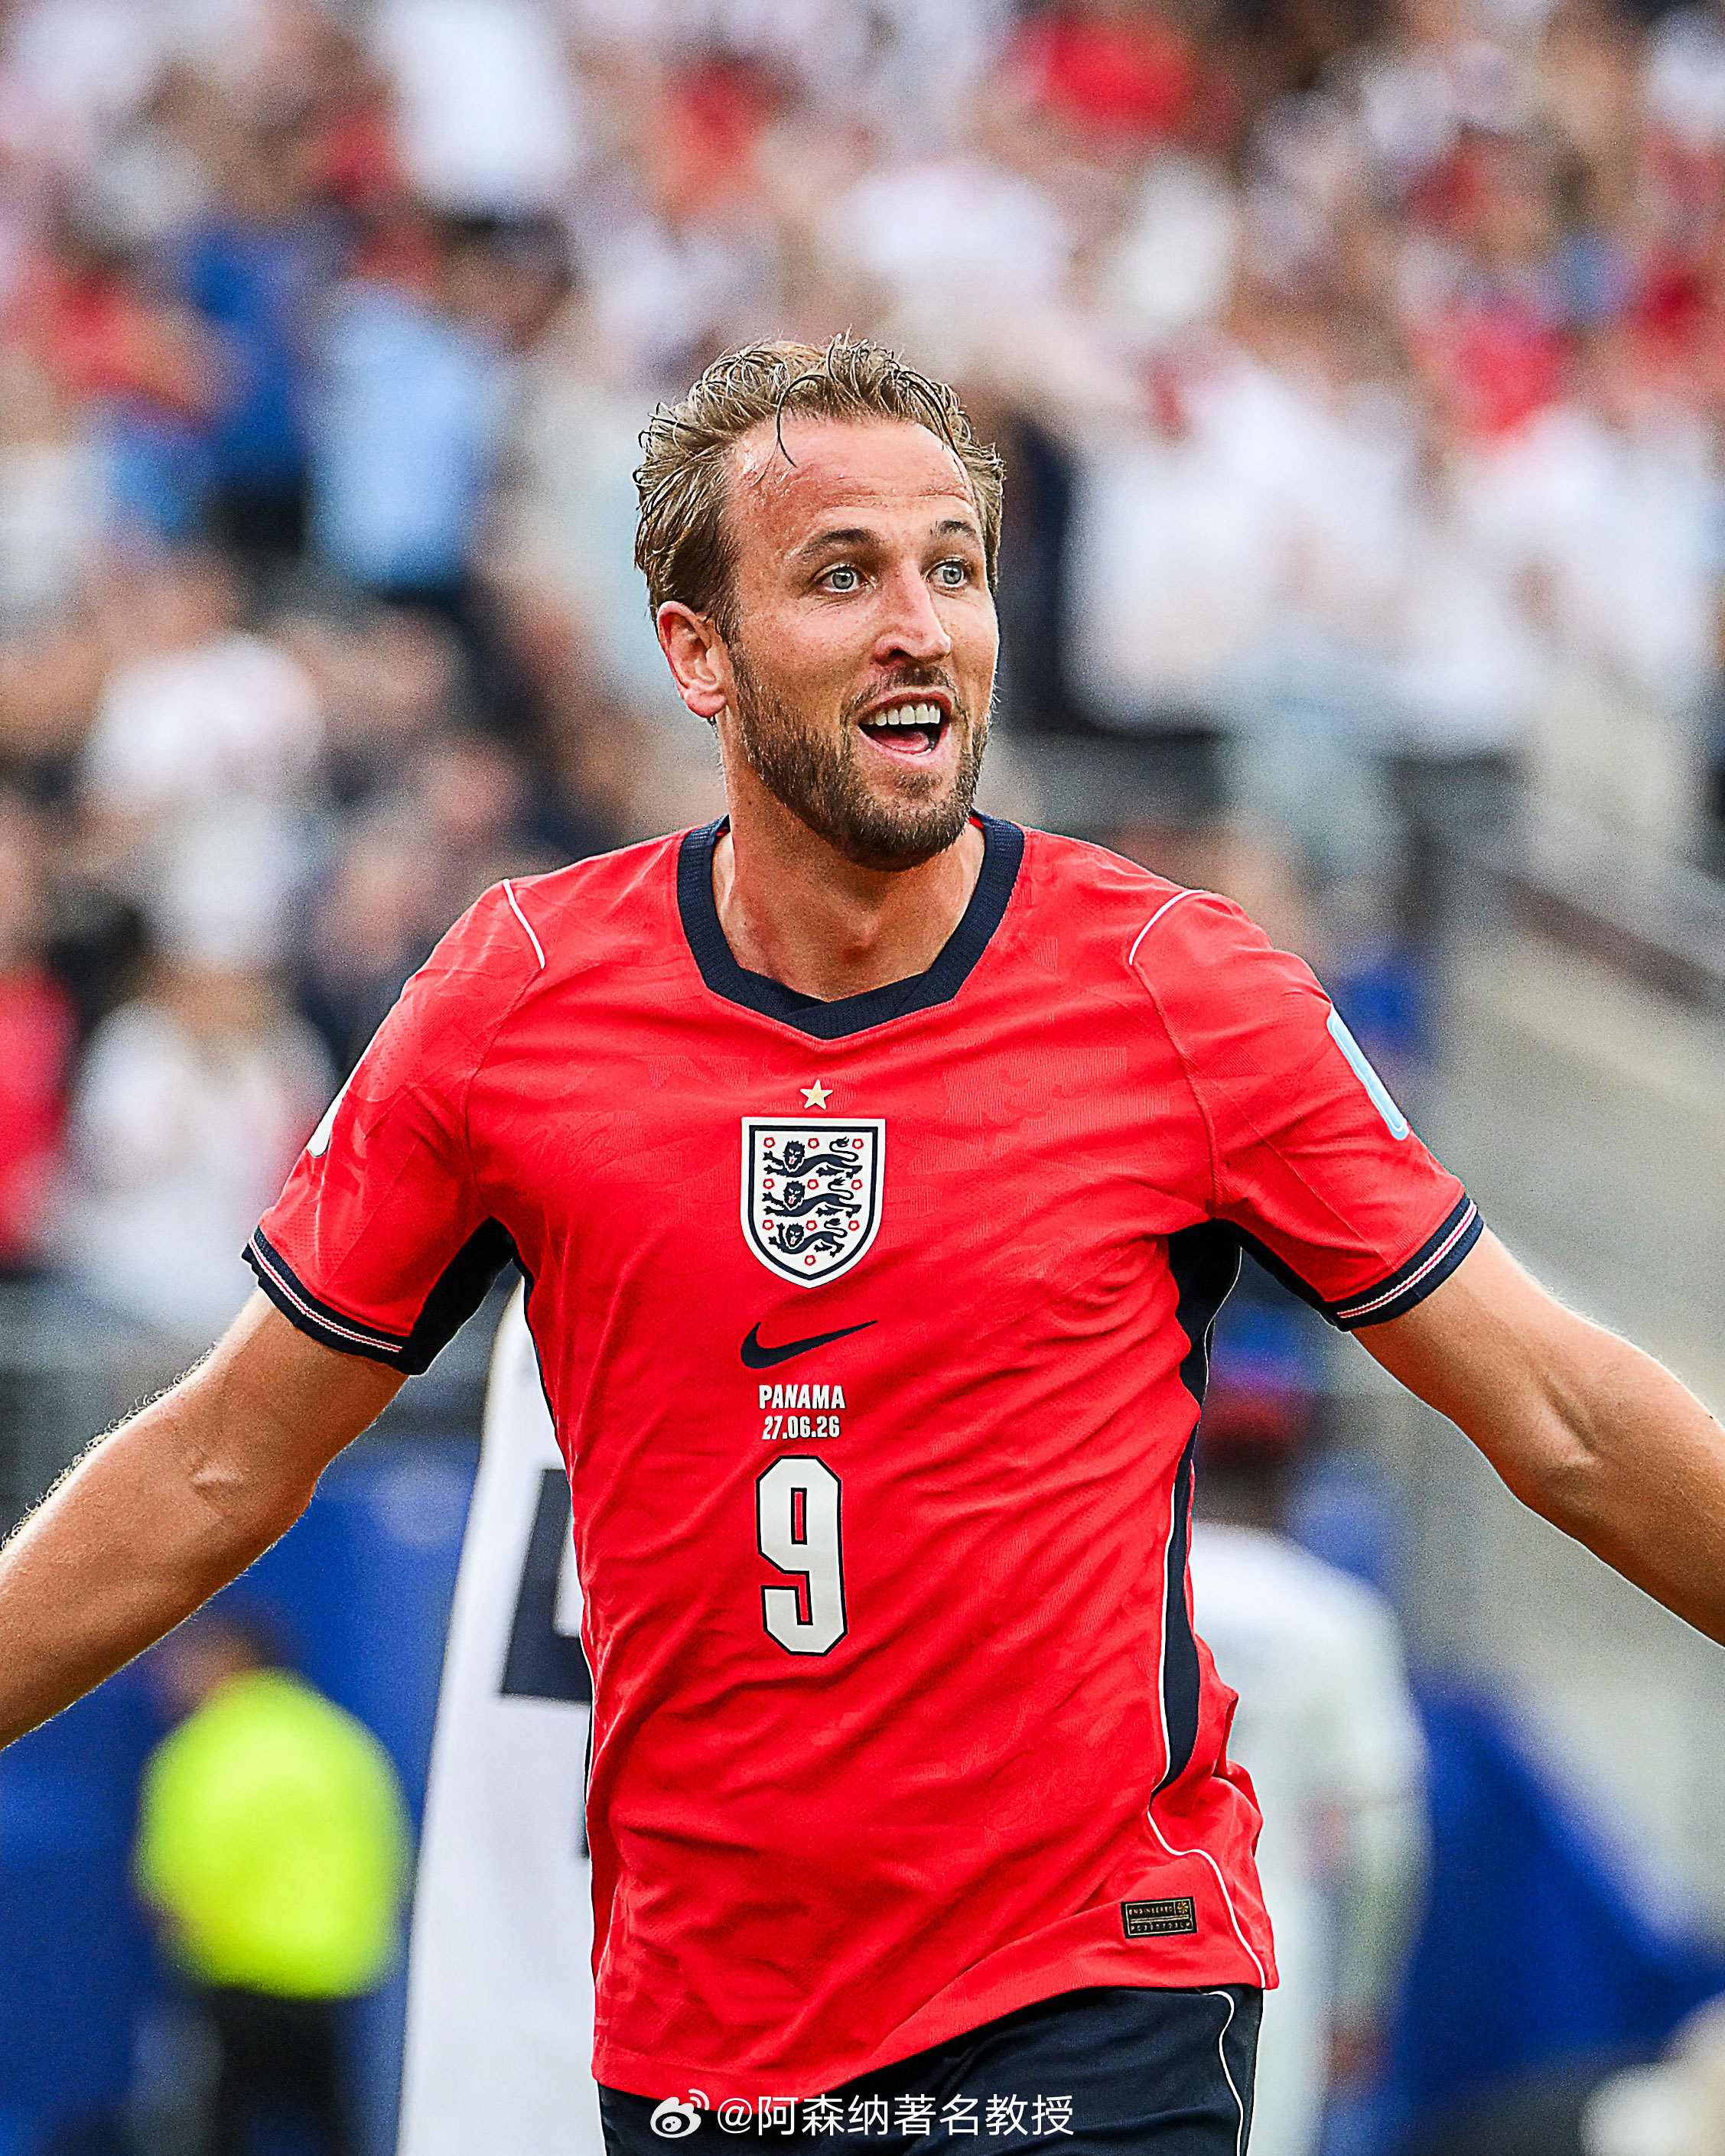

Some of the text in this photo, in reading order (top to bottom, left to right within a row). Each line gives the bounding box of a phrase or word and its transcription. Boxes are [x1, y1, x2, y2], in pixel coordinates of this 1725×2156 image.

[758, 1384, 846, 1409] PANAMA
[762, 1415, 841, 1439] 27.06.26
[755, 1455, 848, 1657] 9
